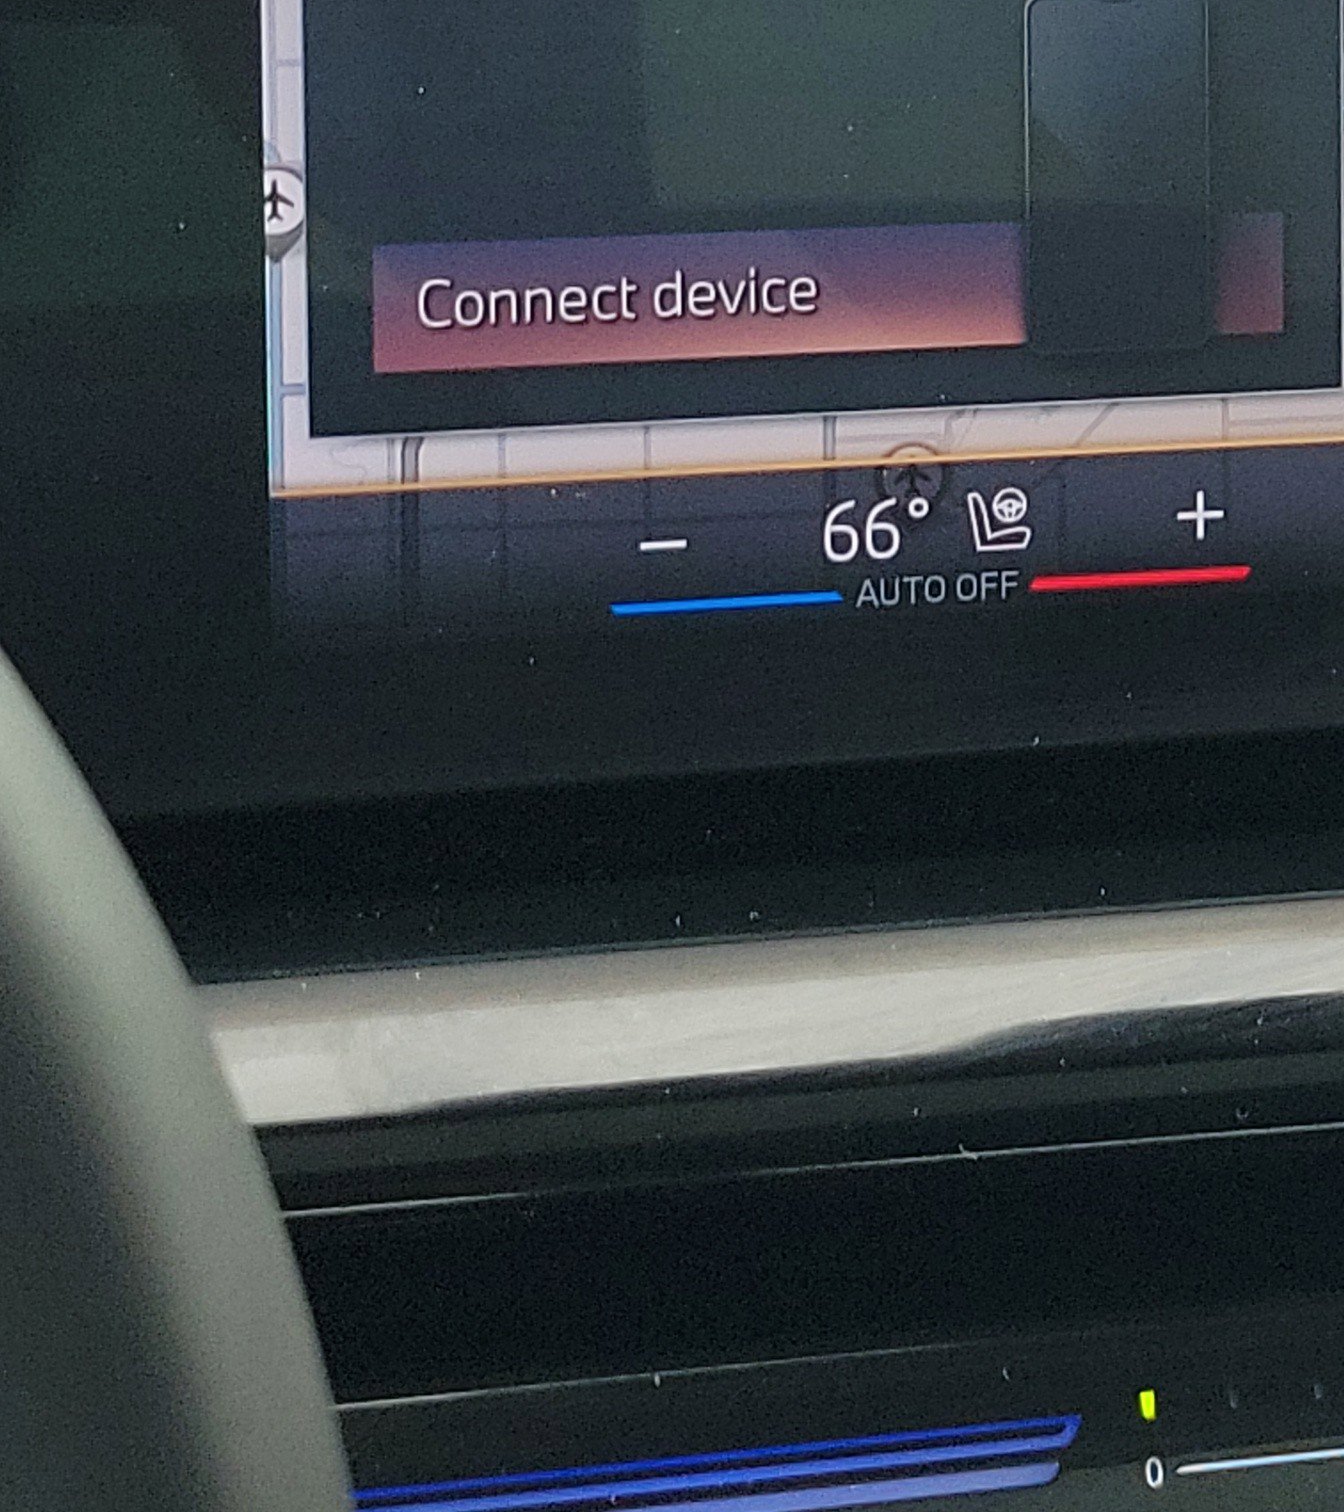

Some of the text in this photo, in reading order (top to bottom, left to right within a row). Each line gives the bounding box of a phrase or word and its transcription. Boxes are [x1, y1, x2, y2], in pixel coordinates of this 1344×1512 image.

[418, 267, 818, 329] Connect device
[857, 570, 1019, 610] AUTO OFF
